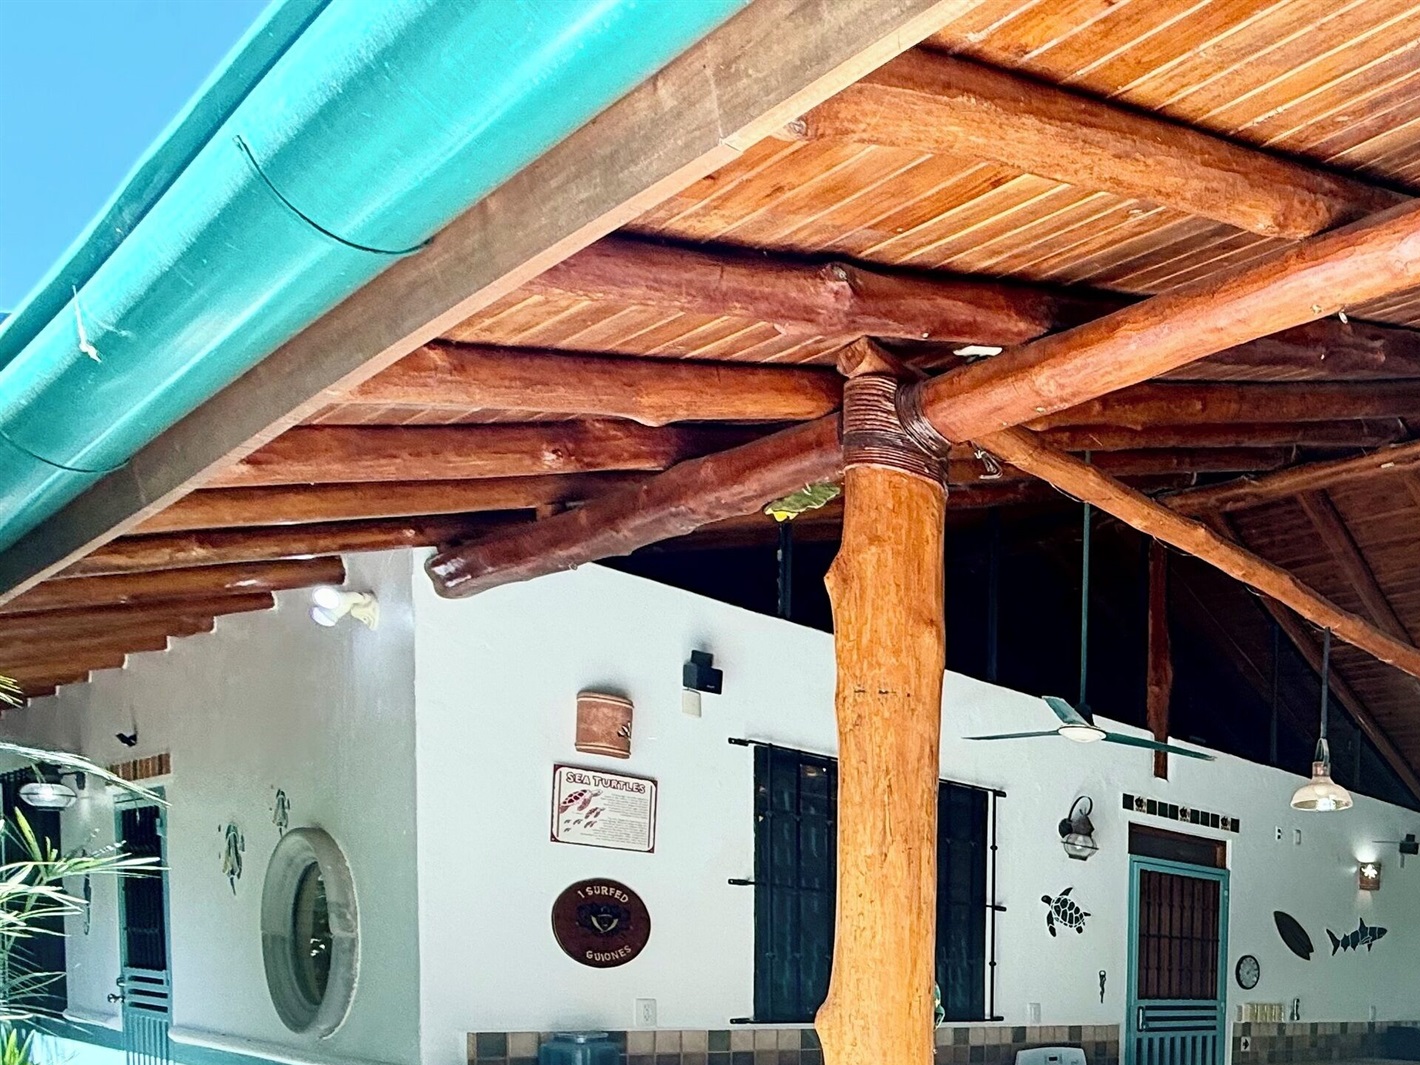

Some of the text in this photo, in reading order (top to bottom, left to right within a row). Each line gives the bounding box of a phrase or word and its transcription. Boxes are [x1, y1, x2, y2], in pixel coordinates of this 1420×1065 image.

[567, 772, 645, 793] SEA TURTLES
[577, 885, 629, 903] I SURFED
[586, 945, 632, 962] GUIONES
